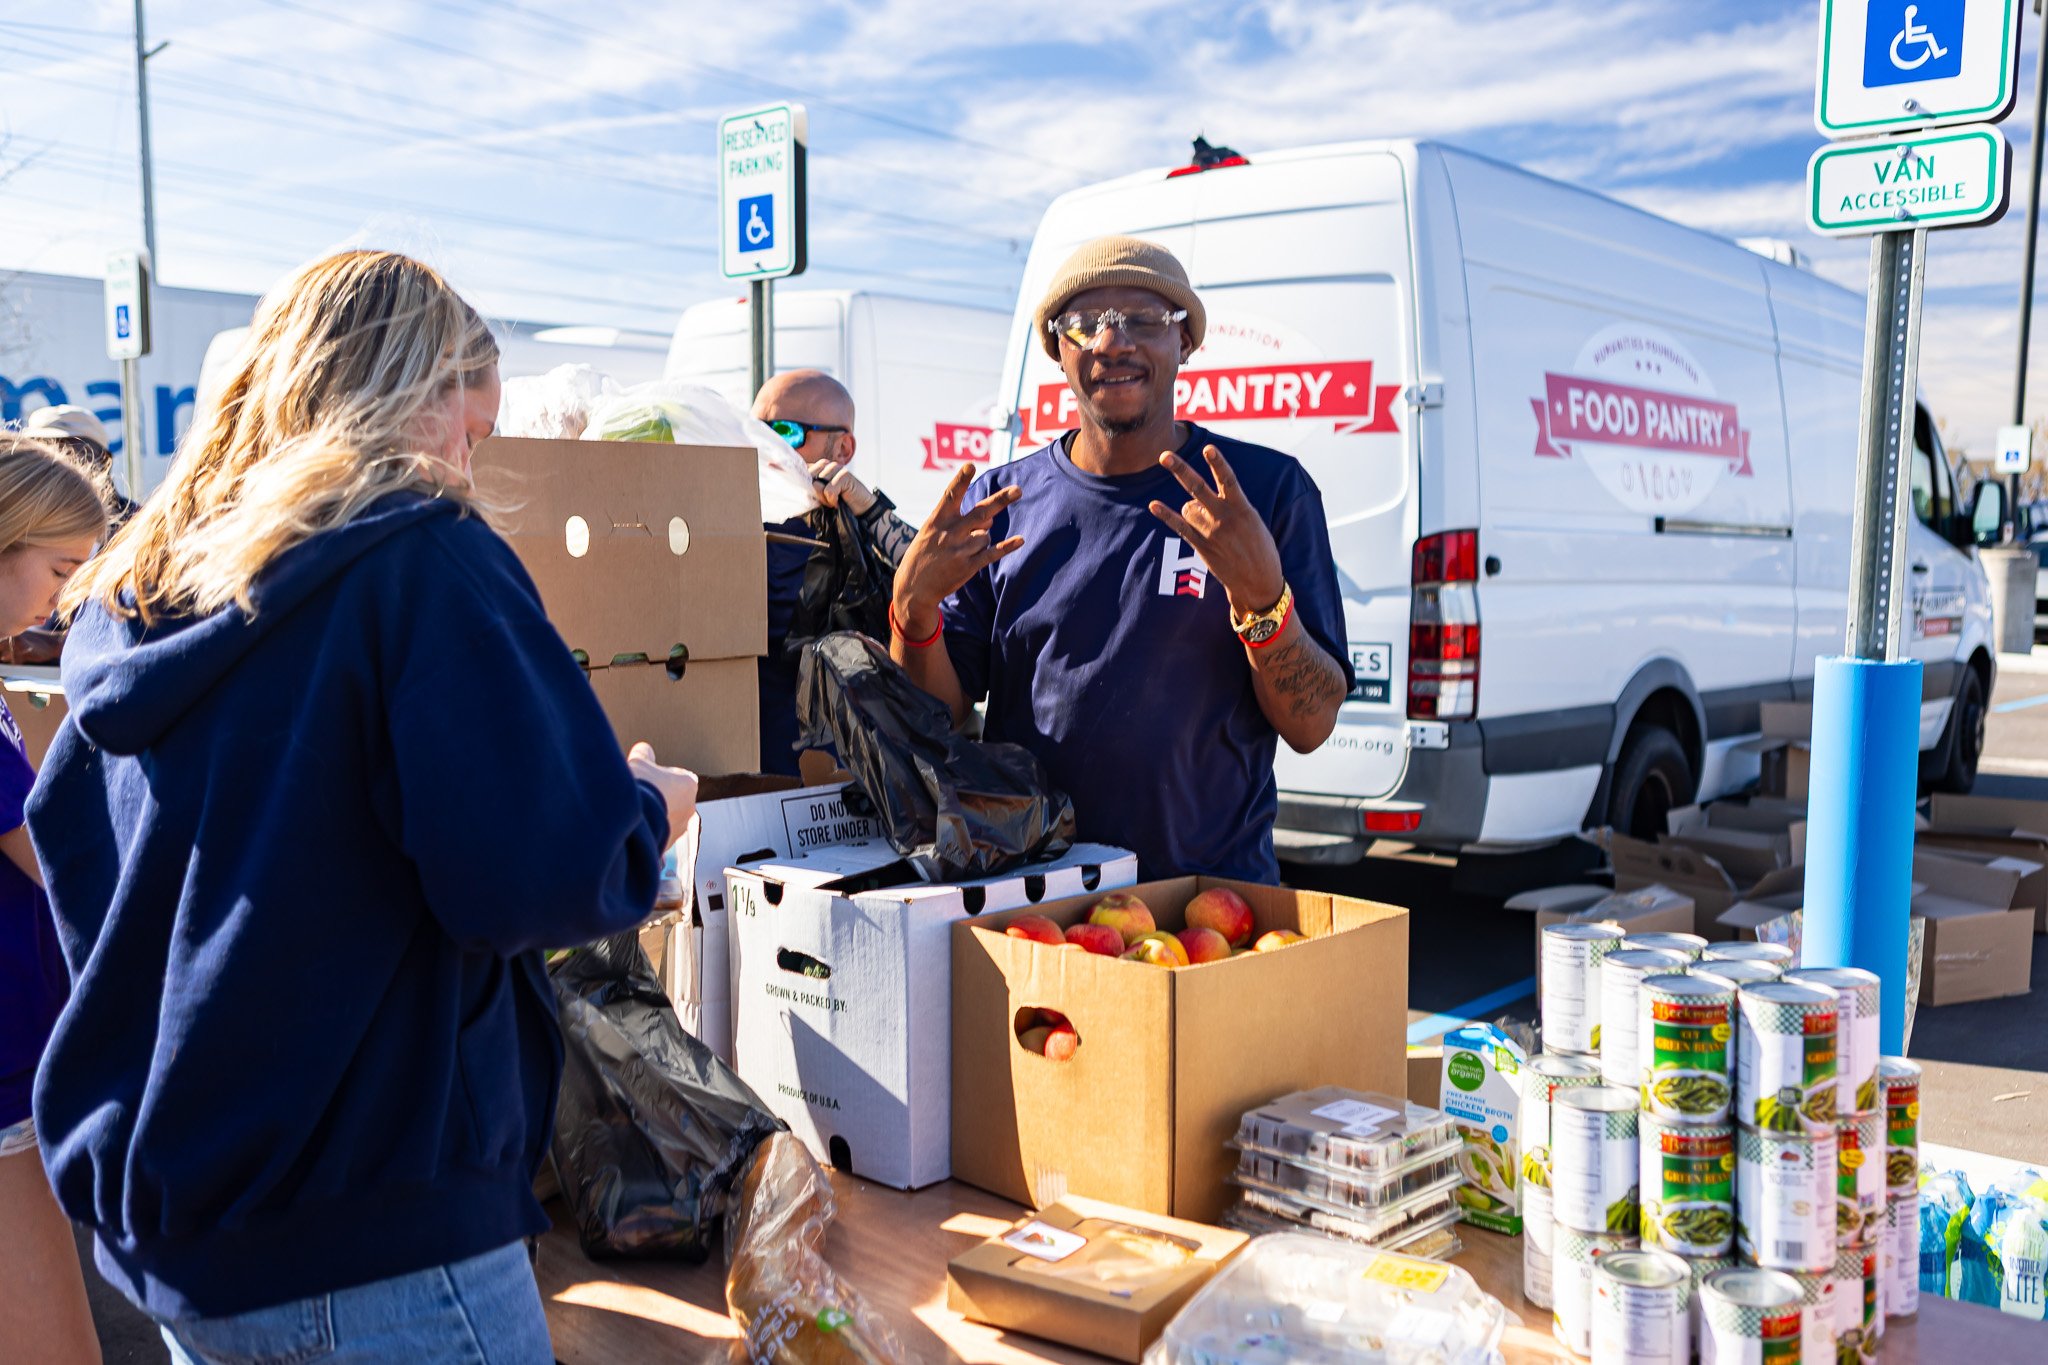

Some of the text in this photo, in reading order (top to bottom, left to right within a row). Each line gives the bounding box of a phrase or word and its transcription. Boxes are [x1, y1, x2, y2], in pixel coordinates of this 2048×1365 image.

[725, 121, 786, 151] RESERVED
[730, 150, 782, 178] PARKING
[1873, 155, 1934, 185] VAN
[1840, 181, 1966, 212] ACCESSIBLE
[1208, 324, 1284, 350] UNDATION
[1173, 371, 1333, 415] PANTRY
[1568, 387, 1724, 448] FOOD PANTRY
[953, 428, 992, 458] FO
[810, 803, 826, 822] DO
[797, 825, 832, 847] STORE
[833, 820, 870, 841] UNDER
[765, 982, 848, 1013] GROWN & PACKED BY:
[1654, 1036, 1690, 1051] GREEN
[1451, 1067, 1482, 1082] organic
[778, 1083, 841, 1111] PRODUCE OF U.S.A.
[1445, 1098, 1513, 1121] CHICKEN BROTH
[1664, 1169, 1701, 1184] GREEN
[2006, 1273, 2039, 1304] LIFE
